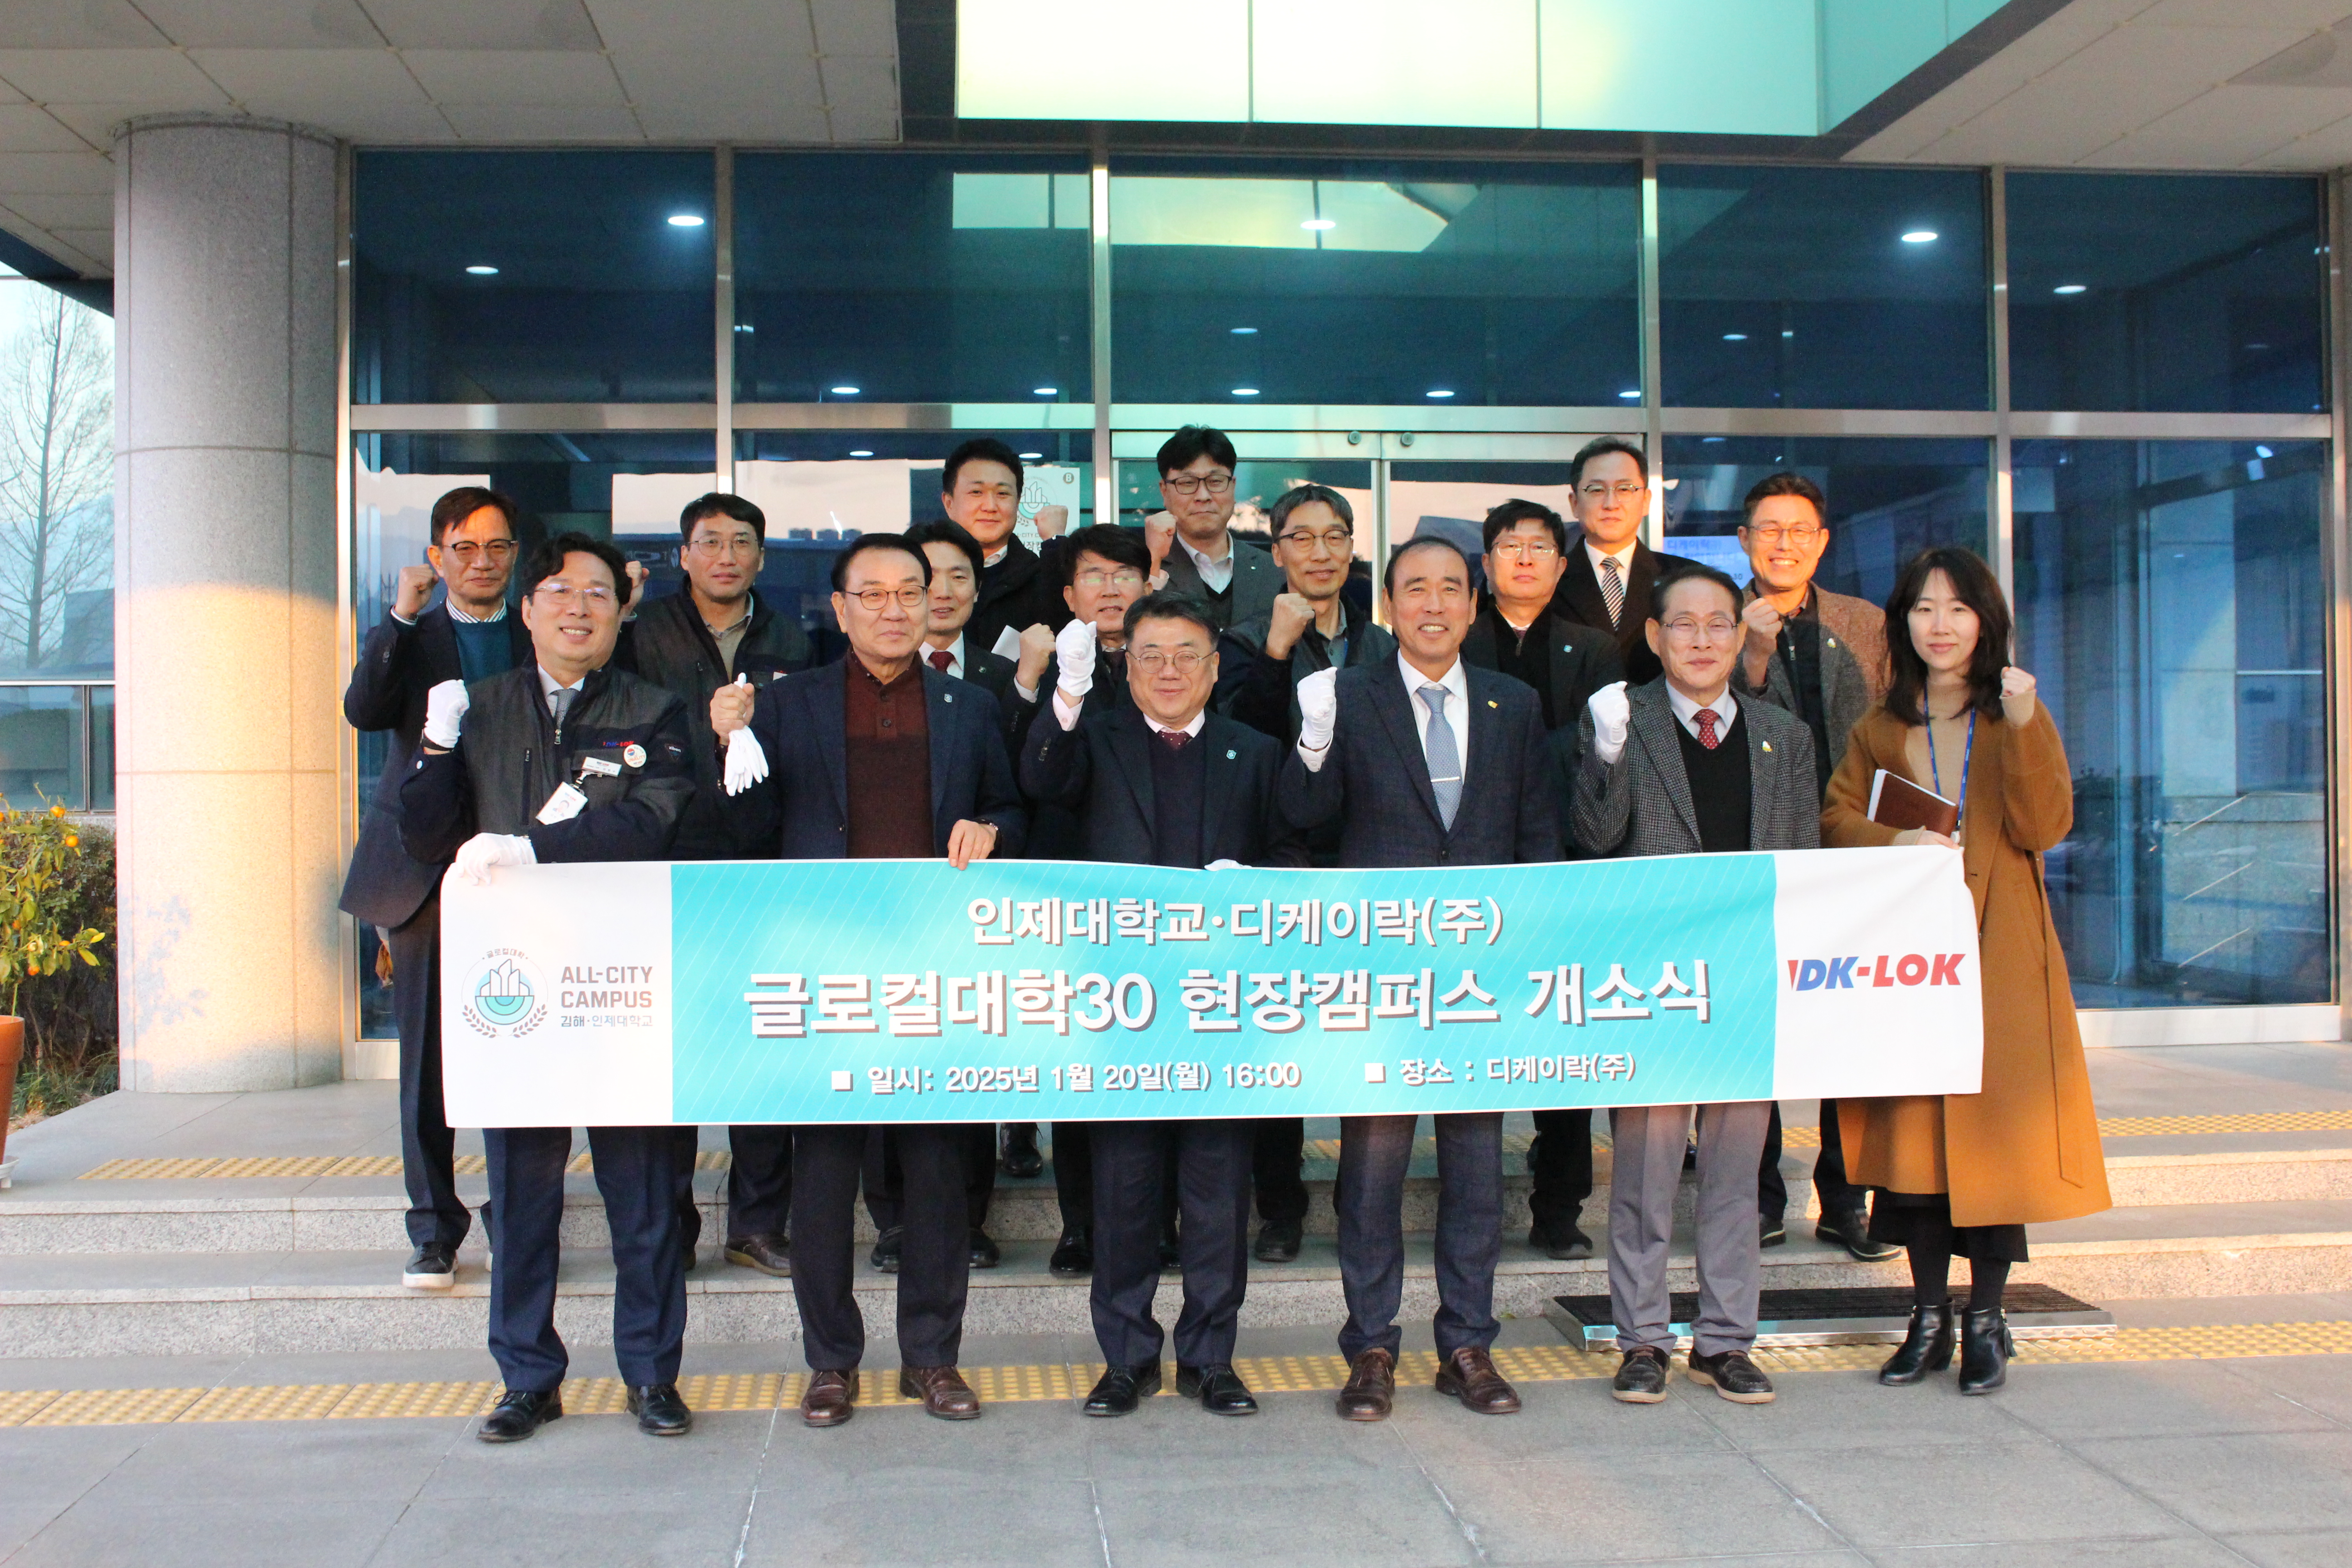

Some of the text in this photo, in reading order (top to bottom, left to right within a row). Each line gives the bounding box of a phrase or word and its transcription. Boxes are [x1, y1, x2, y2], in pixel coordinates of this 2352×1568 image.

[968, 896, 1503, 947] 인제대학교·디케이락(주)
[561, 966, 653, 984] ALL-CITY
[1788, 954, 1966, 991] DK-LOK
[561, 991, 652, 1008] CAMPUS
[744, 959, 1710, 1038] 글로컬대학30 현장캠퍼스 개소식
[868, 1061, 1302, 1095] 일시: 2025년 1월 20일(월) 16:00
[1399, 1058, 1454, 1087] 장소
[1487, 1052, 1636, 1083] 디케이락(주)
